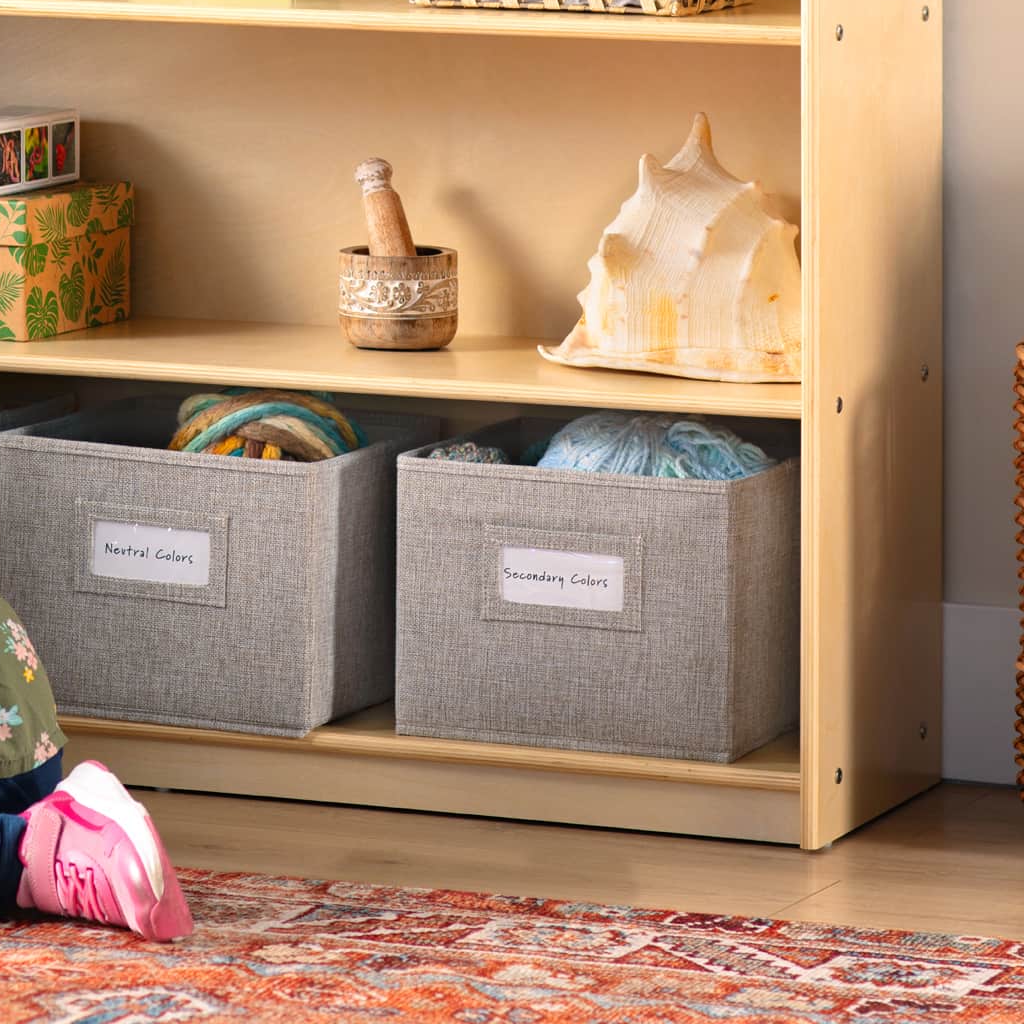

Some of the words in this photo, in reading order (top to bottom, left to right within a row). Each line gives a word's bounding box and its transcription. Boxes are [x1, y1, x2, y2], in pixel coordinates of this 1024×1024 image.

[155, 548, 193, 564] Colors
[503, 567, 564, 589] Secondary
[570, 573, 608, 588] Colors
